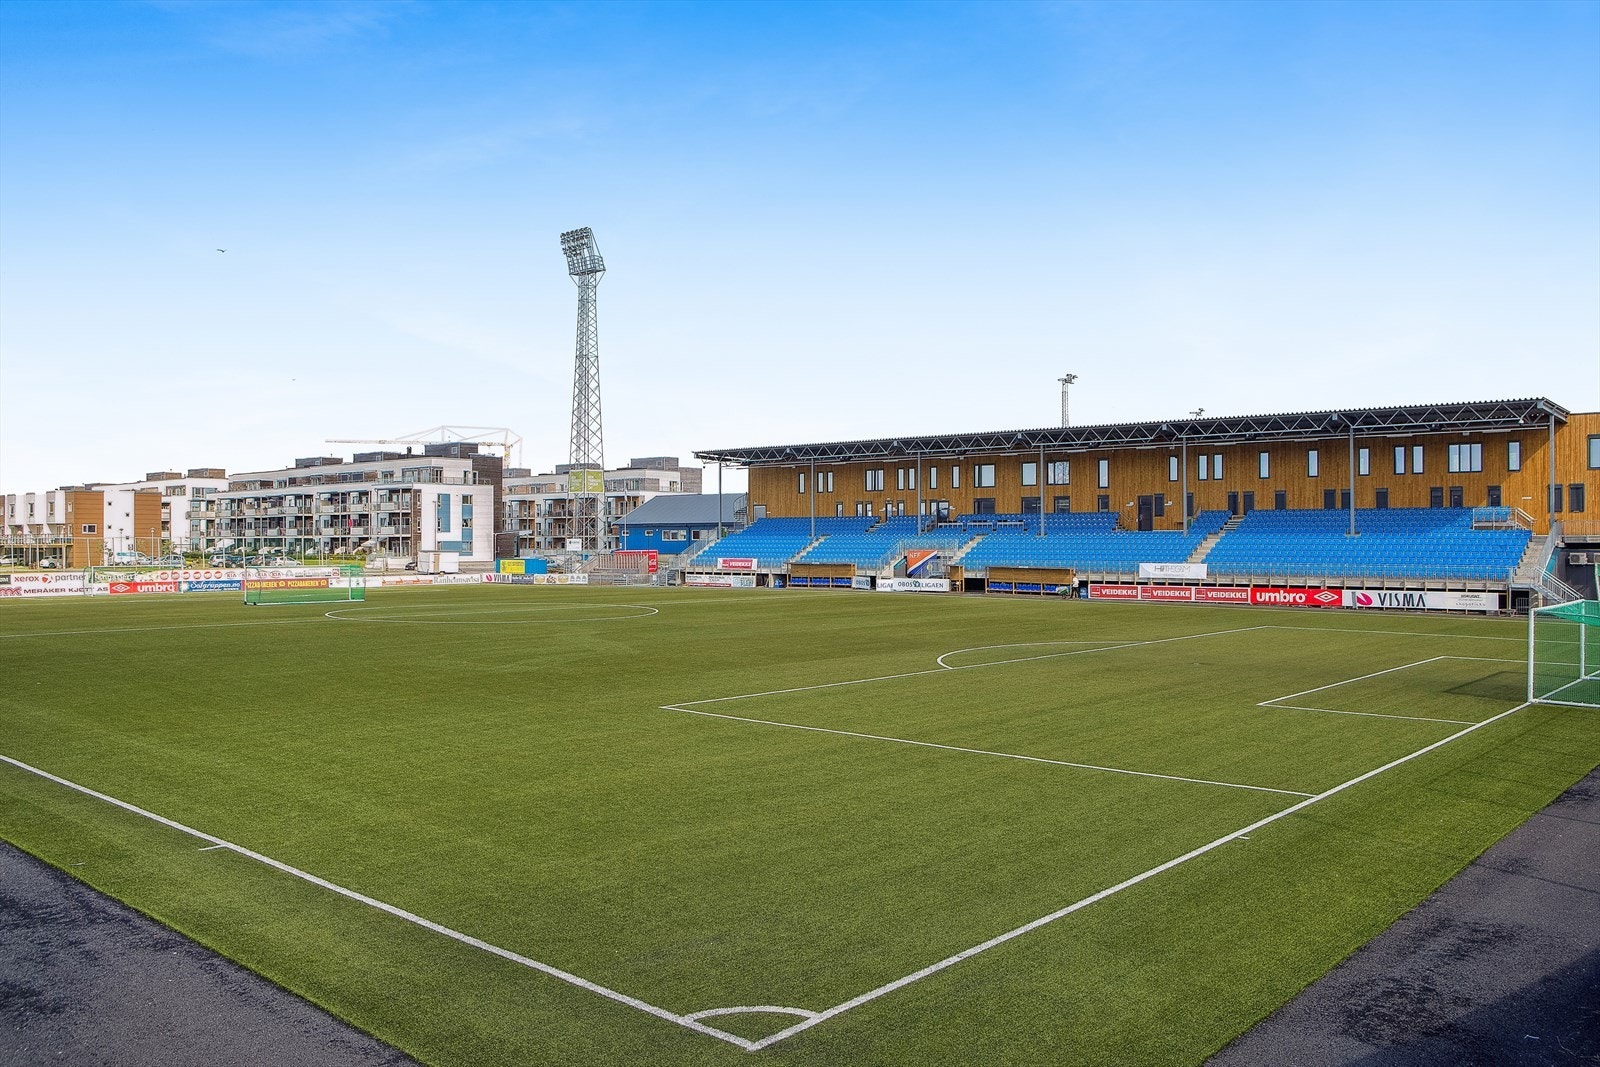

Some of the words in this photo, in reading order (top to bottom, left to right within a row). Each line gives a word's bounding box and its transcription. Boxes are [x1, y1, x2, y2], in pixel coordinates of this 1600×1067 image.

[54, 573, 87, 581] partner
[433, 575, 480, 584] Ranheimsavisa
[137, 583, 175, 592] umbro
[190, 581, 241, 590] Solgruppen.no
[23, 586, 66, 594] MERÅKER
[1101, 588, 1137, 596] VEIDEKKE
[1152, 589, 1191, 597] VEIDEKKE
[1207, 591, 1248, 599] VEIDEKKE
[1256, 589, 1306, 603] umbro
[1377, 592, 1427, 608] VISMA
